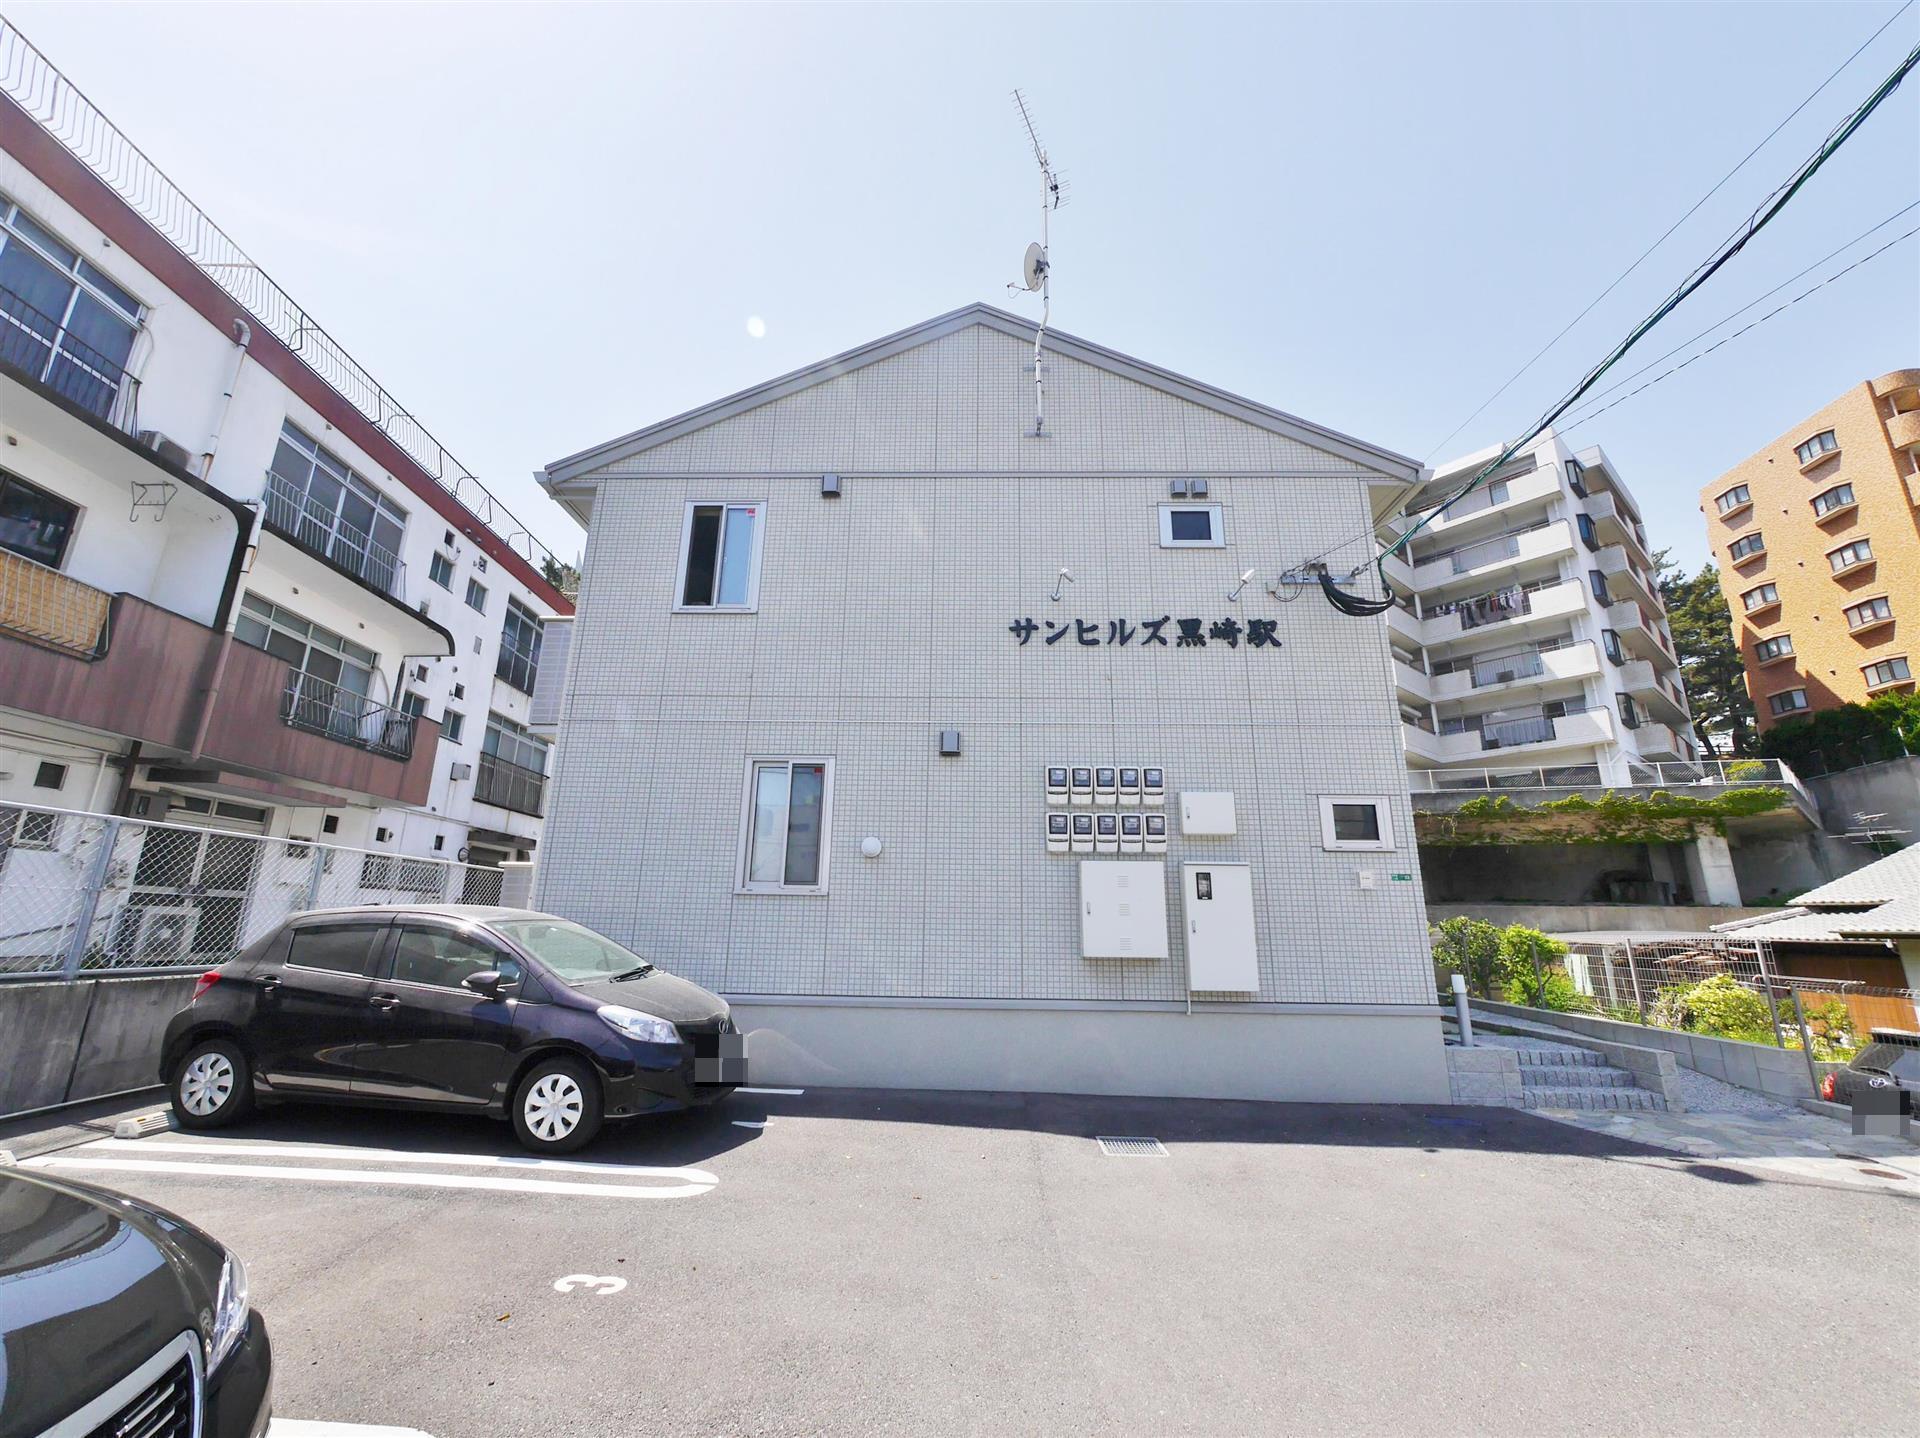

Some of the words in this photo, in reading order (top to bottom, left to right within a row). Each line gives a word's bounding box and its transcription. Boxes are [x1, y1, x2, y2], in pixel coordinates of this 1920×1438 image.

[1009, 615, 1282, 648] サンヒルズ黒崎駅
[553, 1273, 628, 1295] 3
